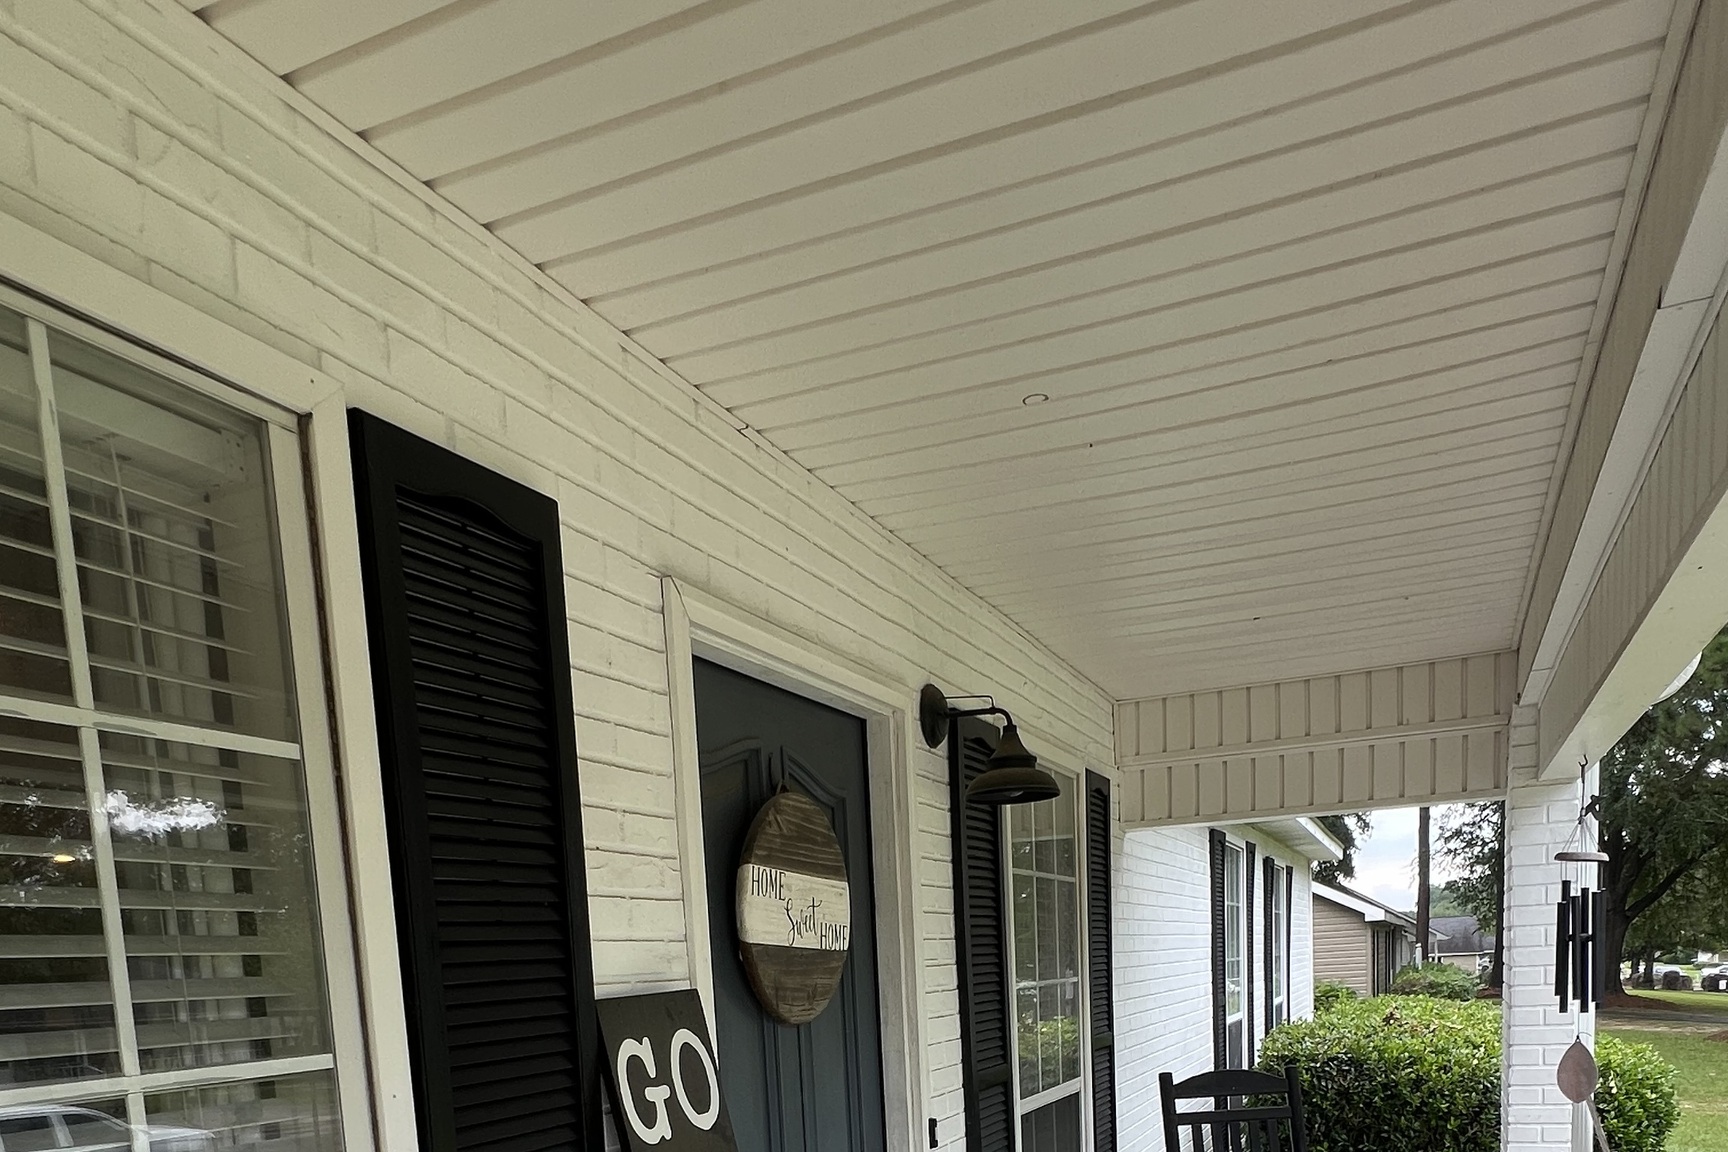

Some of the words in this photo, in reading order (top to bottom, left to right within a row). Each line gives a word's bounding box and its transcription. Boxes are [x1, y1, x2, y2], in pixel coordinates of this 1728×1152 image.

[751, 866, 786, 901] HOME
[784, 896, 823, 946] Sweet
[820, 922, 848, 951] HOME
[617, 1028, 720, 1145] GO
